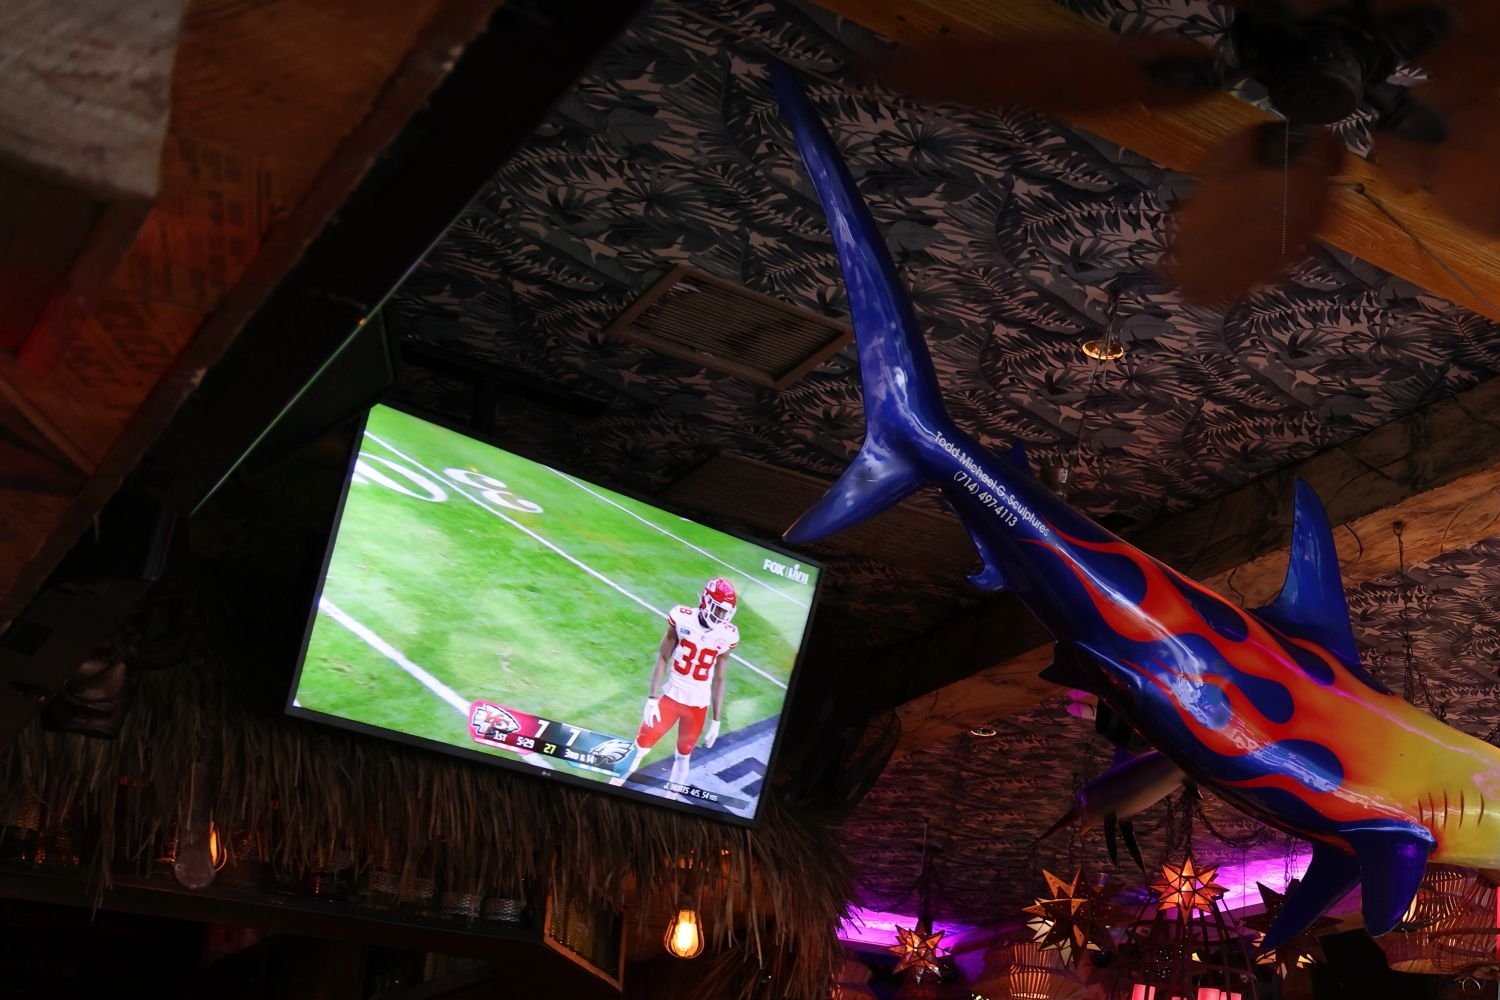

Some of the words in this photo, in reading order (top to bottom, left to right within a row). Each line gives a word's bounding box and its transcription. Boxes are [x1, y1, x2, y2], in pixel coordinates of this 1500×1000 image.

[934, 431, 960, 458] Todd
[959, 452, 998, 490] Michael
[1007, 495, 1050, 537] Sculptures
[953, 470, 980, 495] (714)
[763, 559, 785, 576] FOX
[673, 638, 718, 682] 38
[534, 720, 550, 739] 7
[565, 728, 582, 747] 7
[543, 743, 557, 755] 27
